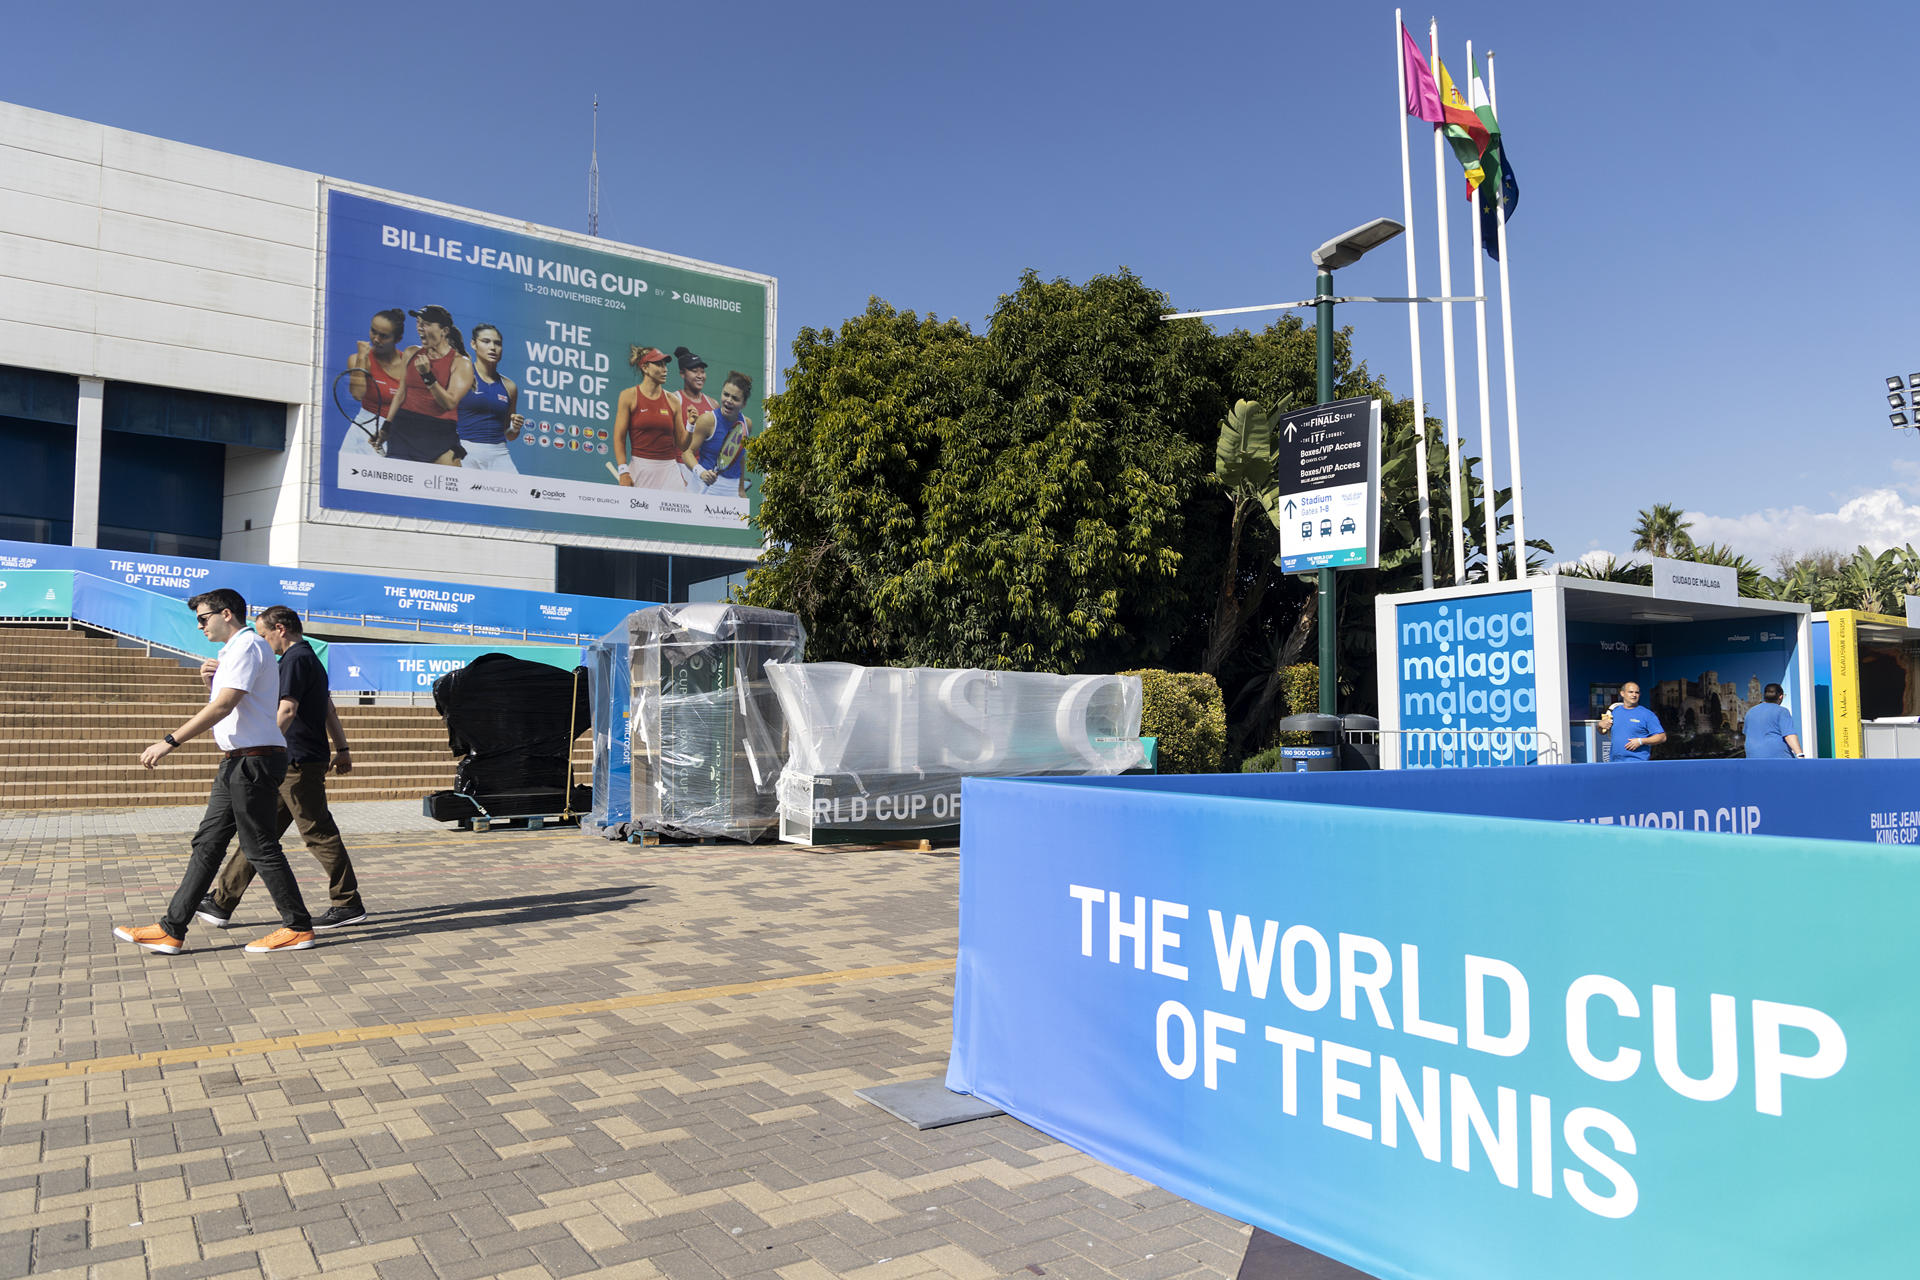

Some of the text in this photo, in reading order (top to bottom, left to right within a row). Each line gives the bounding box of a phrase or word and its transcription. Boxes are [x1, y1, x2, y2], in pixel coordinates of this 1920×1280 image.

[382, 225, 462, 262] BILLIE
[465, 245, 532, 276] JEAN
[538, 258, 597, 289] KING
[600, 272, 648, 297] CUP
[683, 292, 742, 313] GAINBRIDGE
[524, 283, 626, 310] 13-20 NOVIEMBRE 2024
[546, 320, 591, 347] THE
[525, 341, 609, 373] WORLD
[526, 366, 609, 396] CUP OF
[523, 389, 610, 420] TENNIS
[1310, 413, 1340, 427] FINALS
[1311, 433, 1325, 443] ITF
[1300, 441, 1361, 457] Boxes/VIP Access
[361, 469, 413, 483] GAINBRIDGE
[1300, 461, 1361, 477] Boxes/VIP Access
[542, 489, 566, 498] Copilot
[578, 495, 595, 503] TORY
[1301, 494, 1332, 506] Stadium
[110, 560, 209, 579] THE WORLD CUP
[125, 573, 190, 588] OF TENNIS
[1692, 577, 1699, 586] DE
[384, 586, 475, 603] THE WORLD CUP
[398, 599, 458, 613] OF TENNIS
[1600, 640, 1615, 650] Your
[397, 659, 468, 673] THE WORL
[416, 673, 436, 686] OF
[679, 669, 688, 694] CUP
[679, 767, 689, 795] CUP
[875, 794, 927, 821] CUP
[1715, 805, 1761, 835] CUP
[1871, 812, 1898, 829] BILLIE
[1876, 828, 1918, 844] KING CUP
[1070, 884, 1848, 1117] THE WORLD CUP
[1156, 1000, 1639, 1220] OF TENNIS
